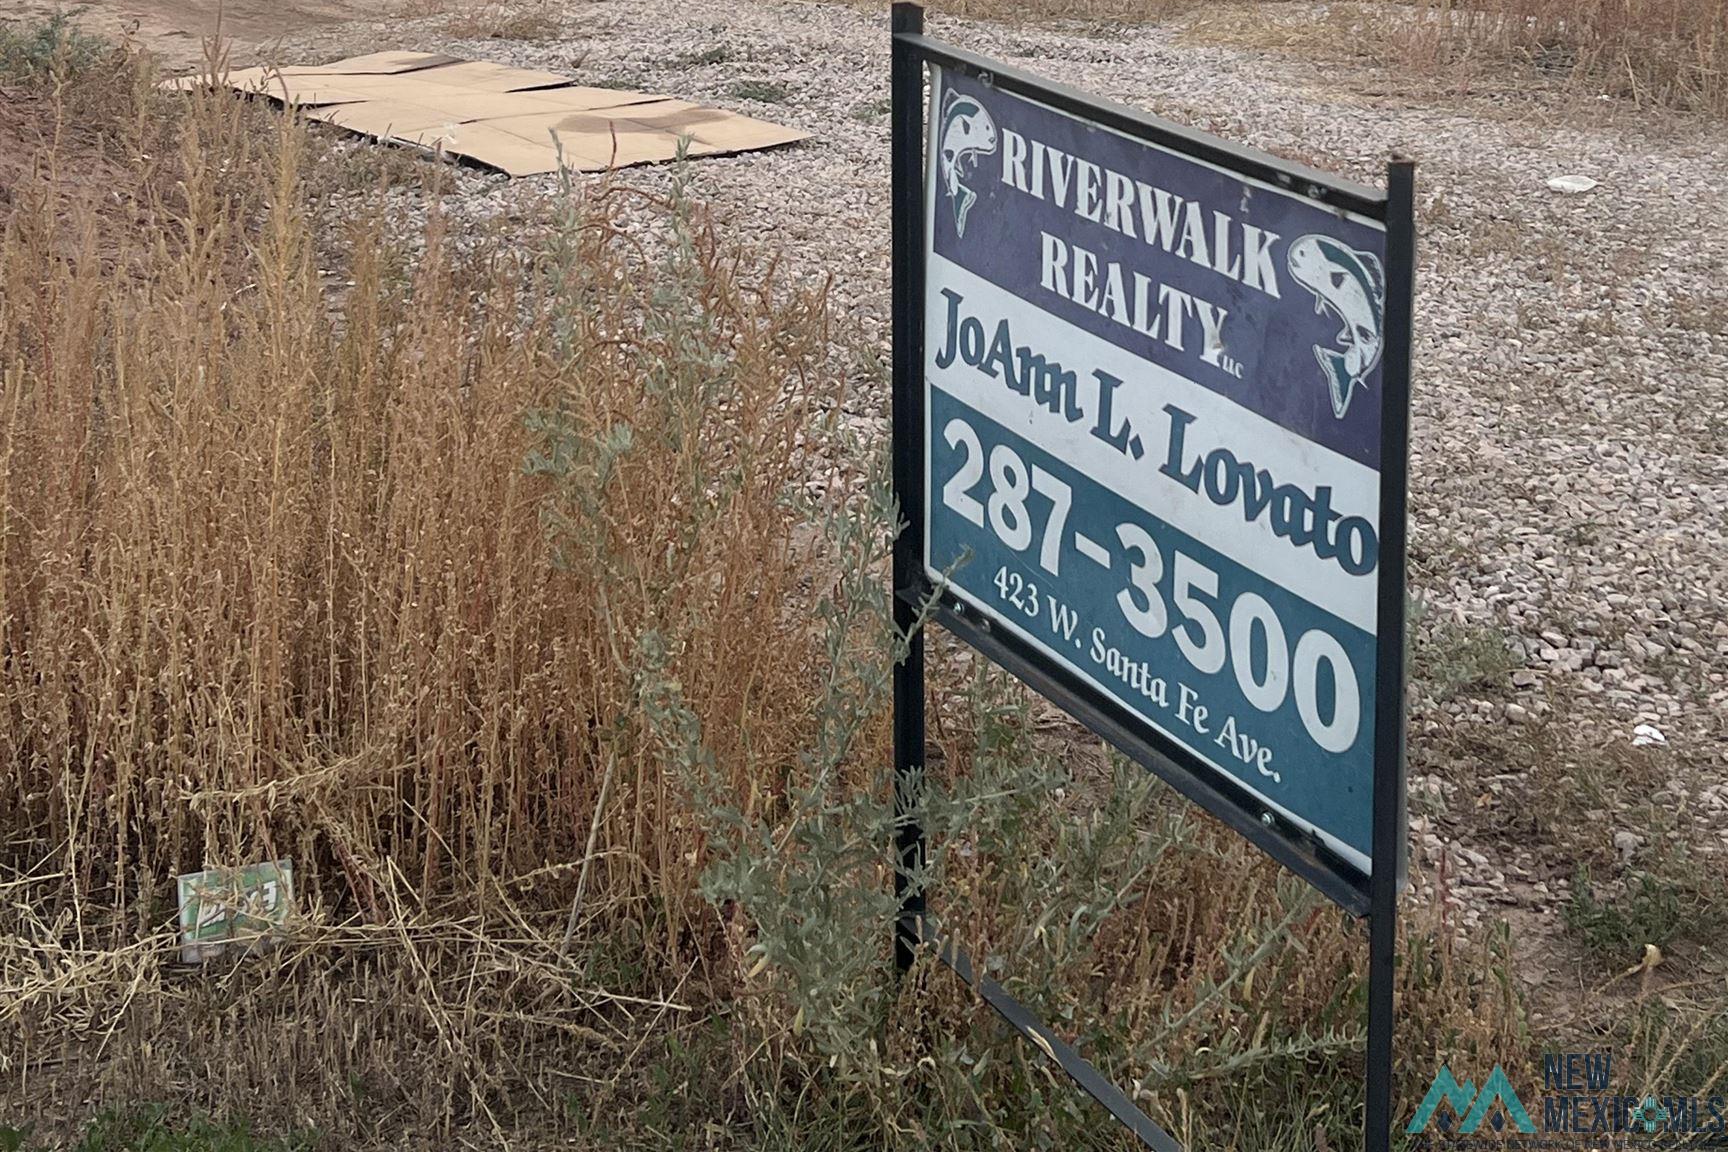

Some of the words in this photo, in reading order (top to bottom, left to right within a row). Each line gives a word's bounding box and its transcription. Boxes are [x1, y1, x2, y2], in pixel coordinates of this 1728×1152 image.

[1002, 128, 1281, 299] RIVERWALK
[1040, 231, 1228, 367] REALTY
[936, 288, 1083, 422] JoAnn
[1090, 369, 1145, 461] L.
[1159, 404, 1378, 576] Lovato
[943, 418, 1361, 753] 287-3500
[993, 566, 1040, 617] 423
[1046, 595, 1082, 649] W.
[1091, 627, 1169, 707] Santa
[1175, 683, 1209, 735] Fe
[1215, 716, 1281, 783] Ave.
